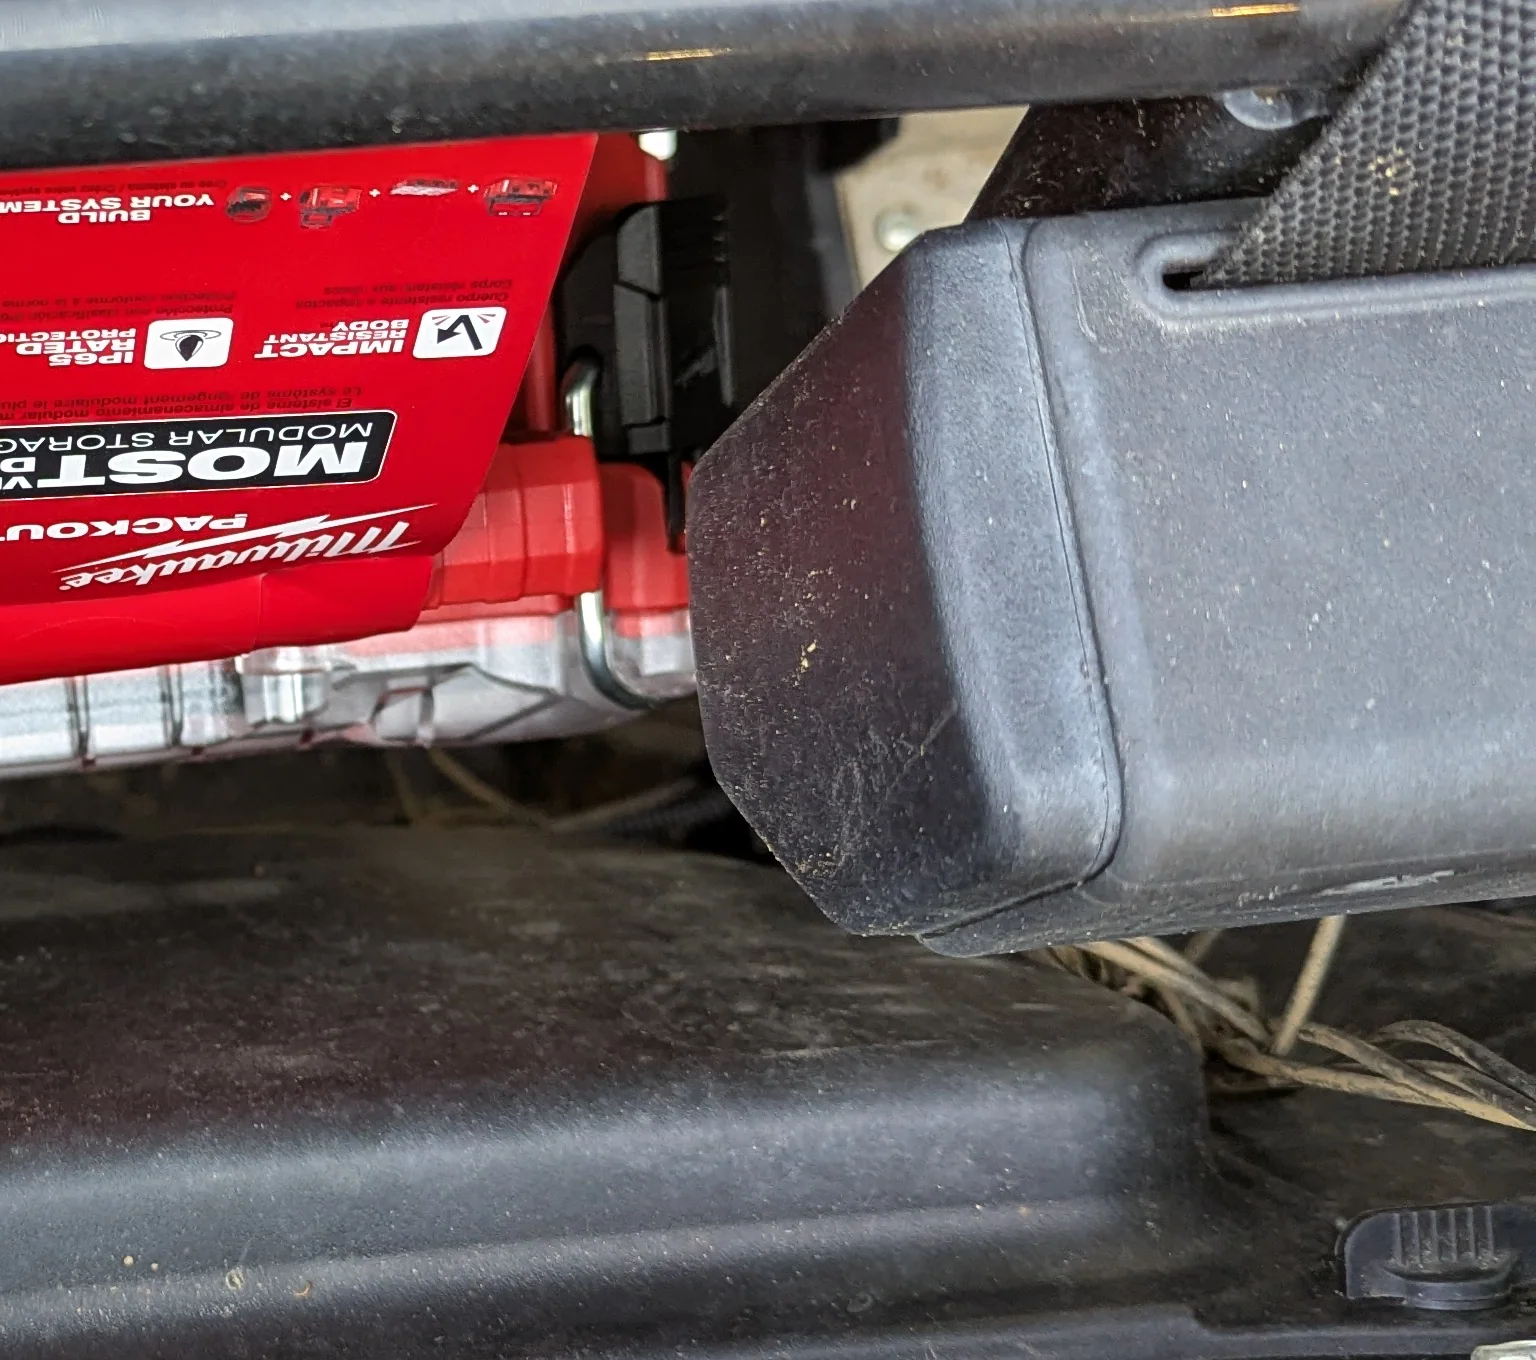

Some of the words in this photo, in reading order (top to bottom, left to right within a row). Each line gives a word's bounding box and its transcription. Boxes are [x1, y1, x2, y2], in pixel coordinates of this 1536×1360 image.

[130, 194, 214, 208] YOUR
[58, 209, 151, 224] BUILD
[330, 318, 410, 332] BODY
[264, 329, 407, 344] RESISTANT
[16, 338, 135, 355] RATED
[254, 339, 404, 359] IMPACT
[48, 351, 134, 366] IP65
[240, 391, 261, 402] de
[20, 407, 89, 422] modular
[239, 402, 260, 413] de
[168, 422, 374, 446] MODULAR
[37, 441, 368, 488] MOST
[59, 521, 421, 590] Milwaukee
